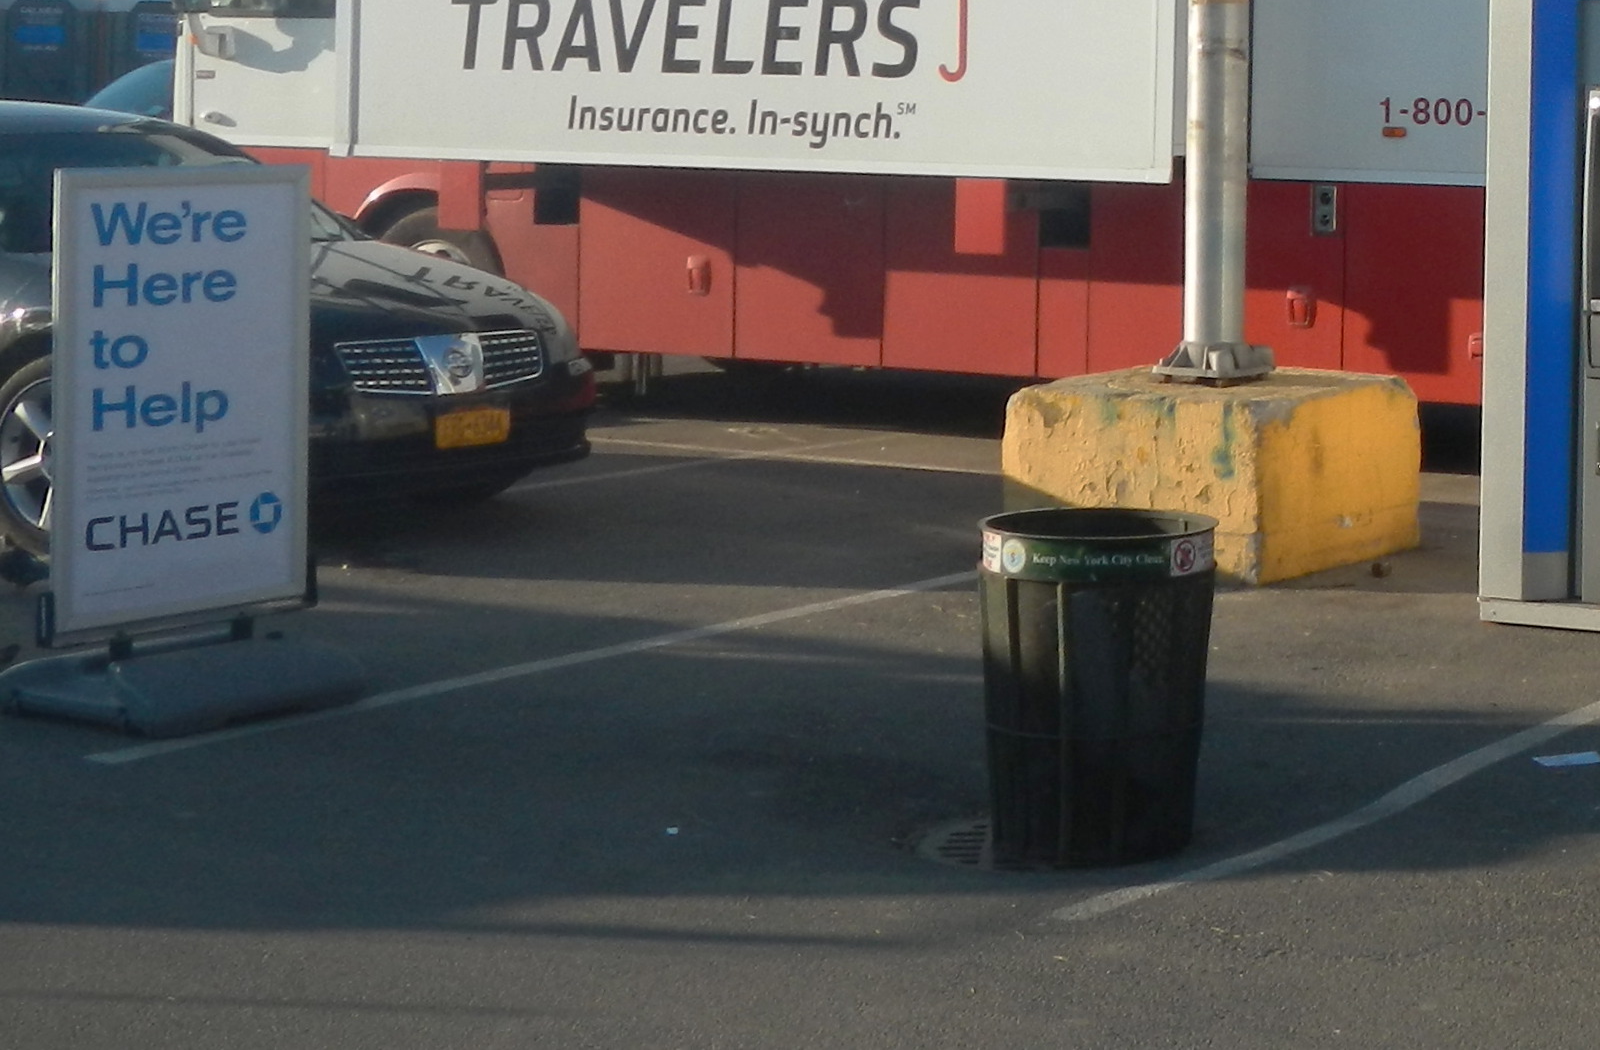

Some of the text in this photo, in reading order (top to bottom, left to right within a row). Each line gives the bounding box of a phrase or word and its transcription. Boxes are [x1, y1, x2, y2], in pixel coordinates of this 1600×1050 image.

[567, 95, 736, 135] Insurance.
[747, 99, 901, 149] In-synch.
[91, 200, 247, 246] We're
[92, 263, 237, 308] Here
[89, 329, 149, 370] to
[91, 381, 229, 433] Help
[85, 501, 240, 551] CHASE
[1032, 553, 1057, 566] Keep
[1084, 555, 1109, 566] York
[1111, 554, 1133, 567] City
